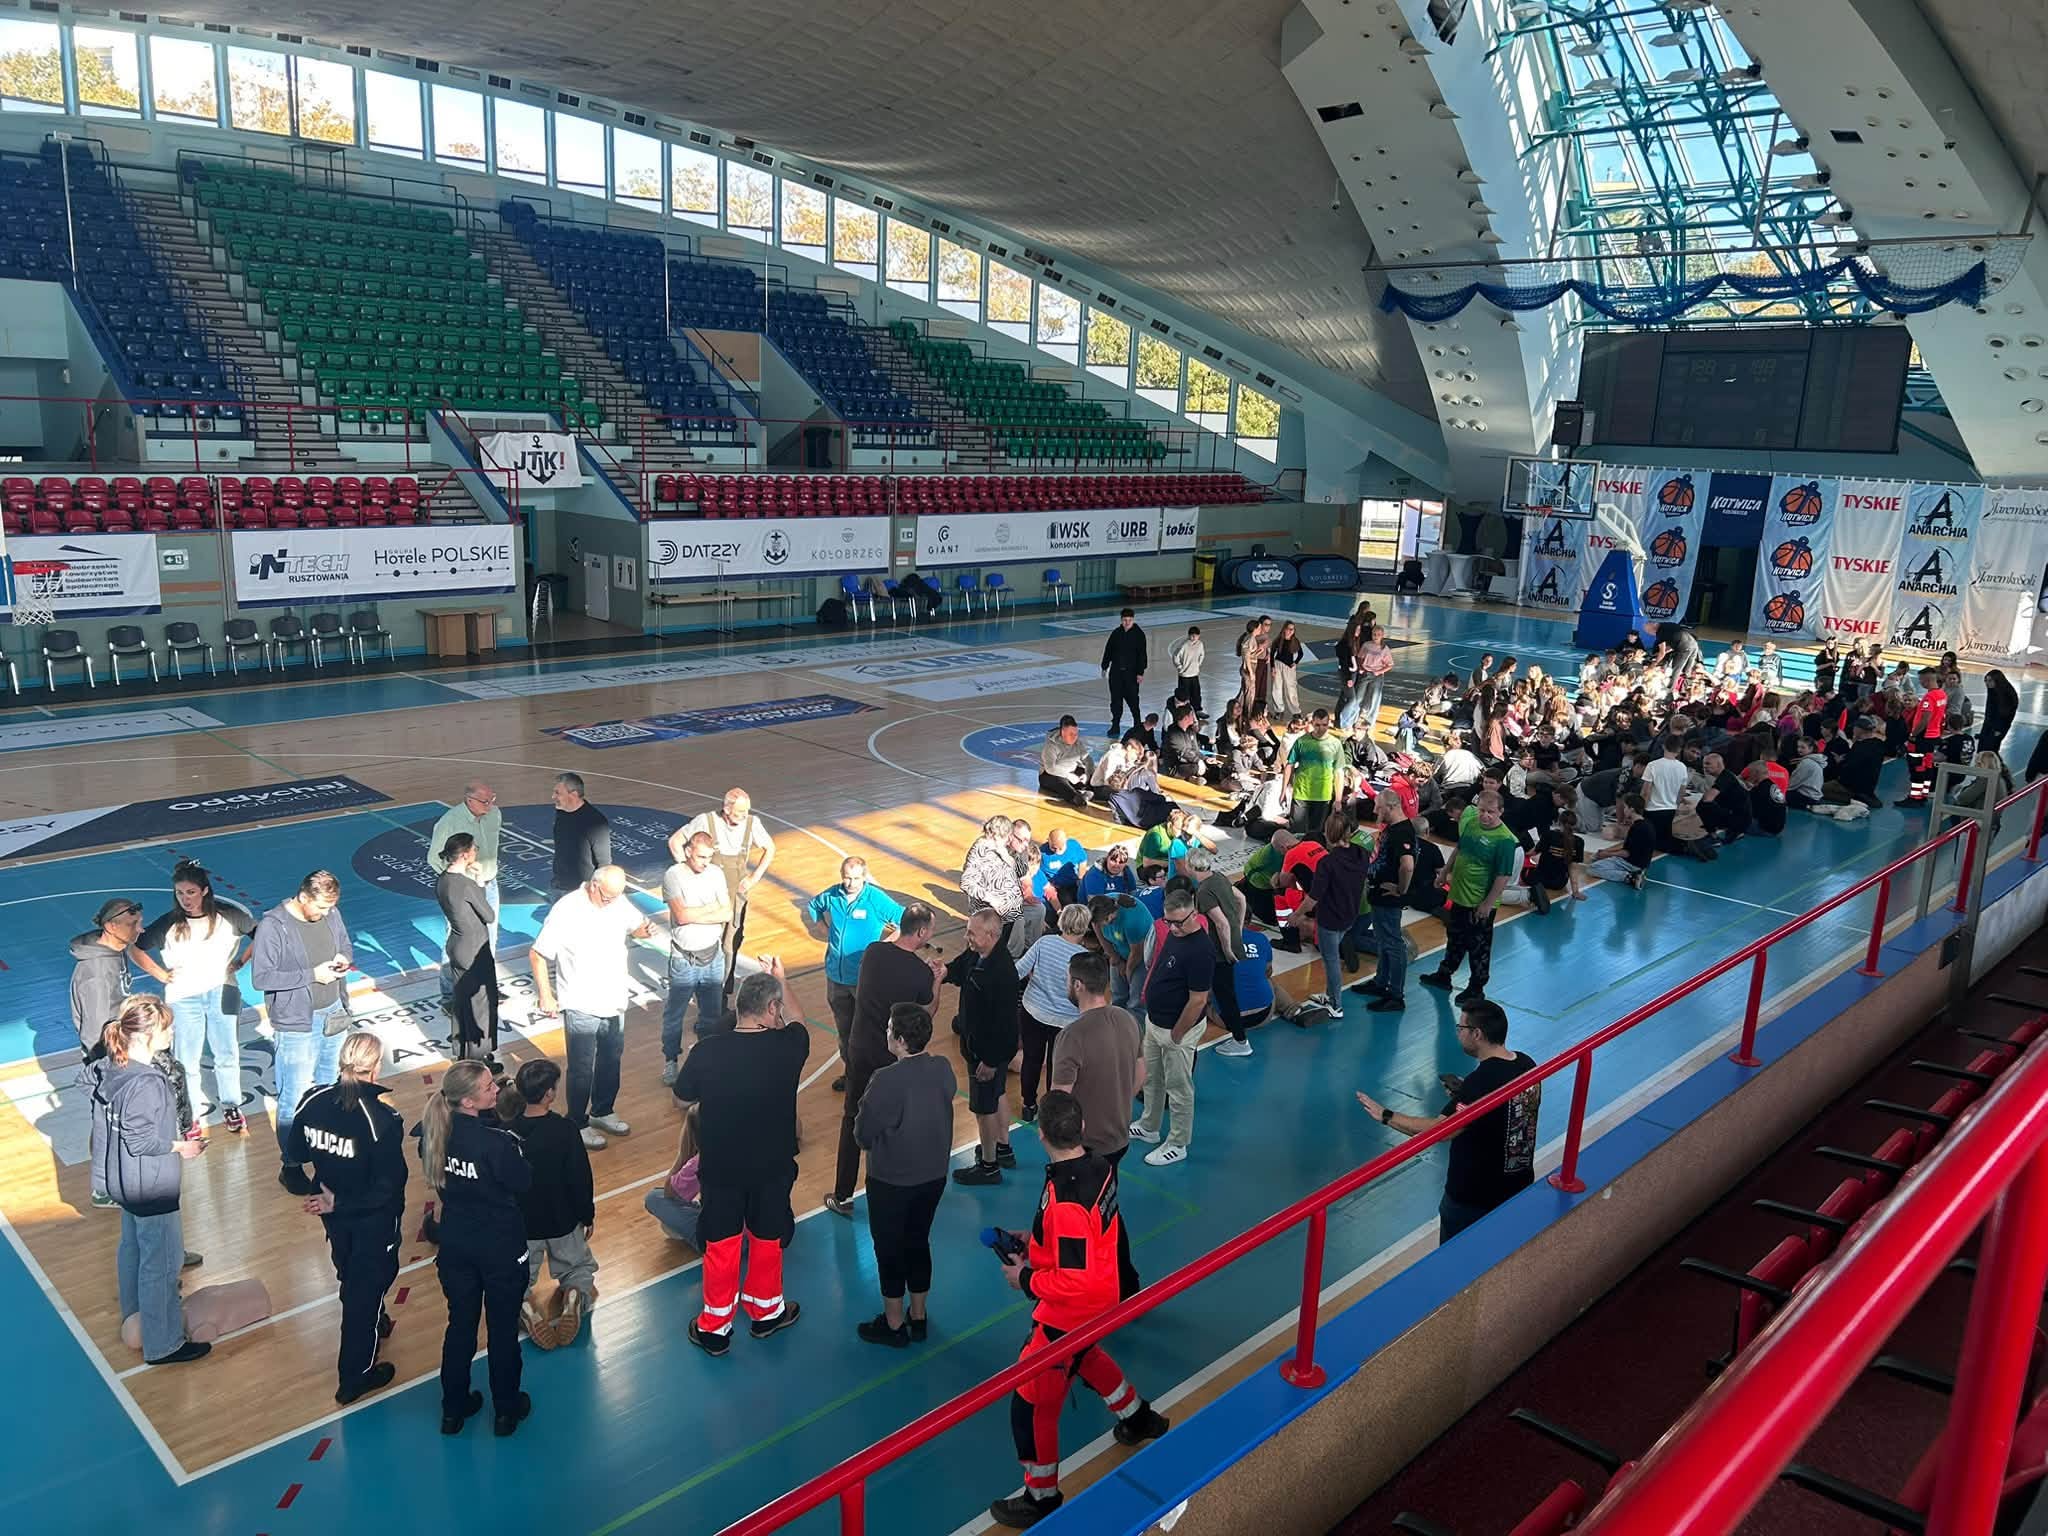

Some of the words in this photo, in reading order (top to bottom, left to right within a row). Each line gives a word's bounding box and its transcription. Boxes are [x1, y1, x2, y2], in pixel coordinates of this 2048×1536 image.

[1660, 503, 1688, 513] KOTWICA
[1711, 496, 1762, 510] KOTWICA
[1843, 494, 1902, 511] TYSKIE
[1781, 513, 1814, 522] KOTWICA
[1059, 521, 1090, 538] WSK
[1120, 521, 1148, 537] URB
[1166, 523, 1196, 536] tobis
[1908, 524, 1968, 539] ANARCHIA
[1050, 540, 1090, 549] konsorcjum
[1588, 535, 1617, 549] TYS
[374, 547, 427, 565] Hotele
[431, 545, 509, 562] POLSKIE
[811, 548, 883, 560] KOŁOBRZEG
[928, 545, 960, 555] GIANT
[1533, 544, 1577, 559] ANARCHIA
[1651, 554, 1680, 565] KOTWICA
[1832, 556, 1891, 573] TYSKIE
[289, 573, 349, 583] RUSZTOWANIA
[1772, 567, 1806, 577] KOTWICA
[1898, 580, 1957, 595] ANARCHIA
[1645, 605, 1673, 616] KOTWICA
[1766, 620, 1798, 629] KOTWICA
[1822, 616, 1881, 634] TYSKIE
[1890, 635, 1948, 651] ANARCHIA
[168, 780, 348, 811] Oddychaj
[303, 1125, 354, 1159] POLICJA
[445, 1156, 478, 1180] ICJA
